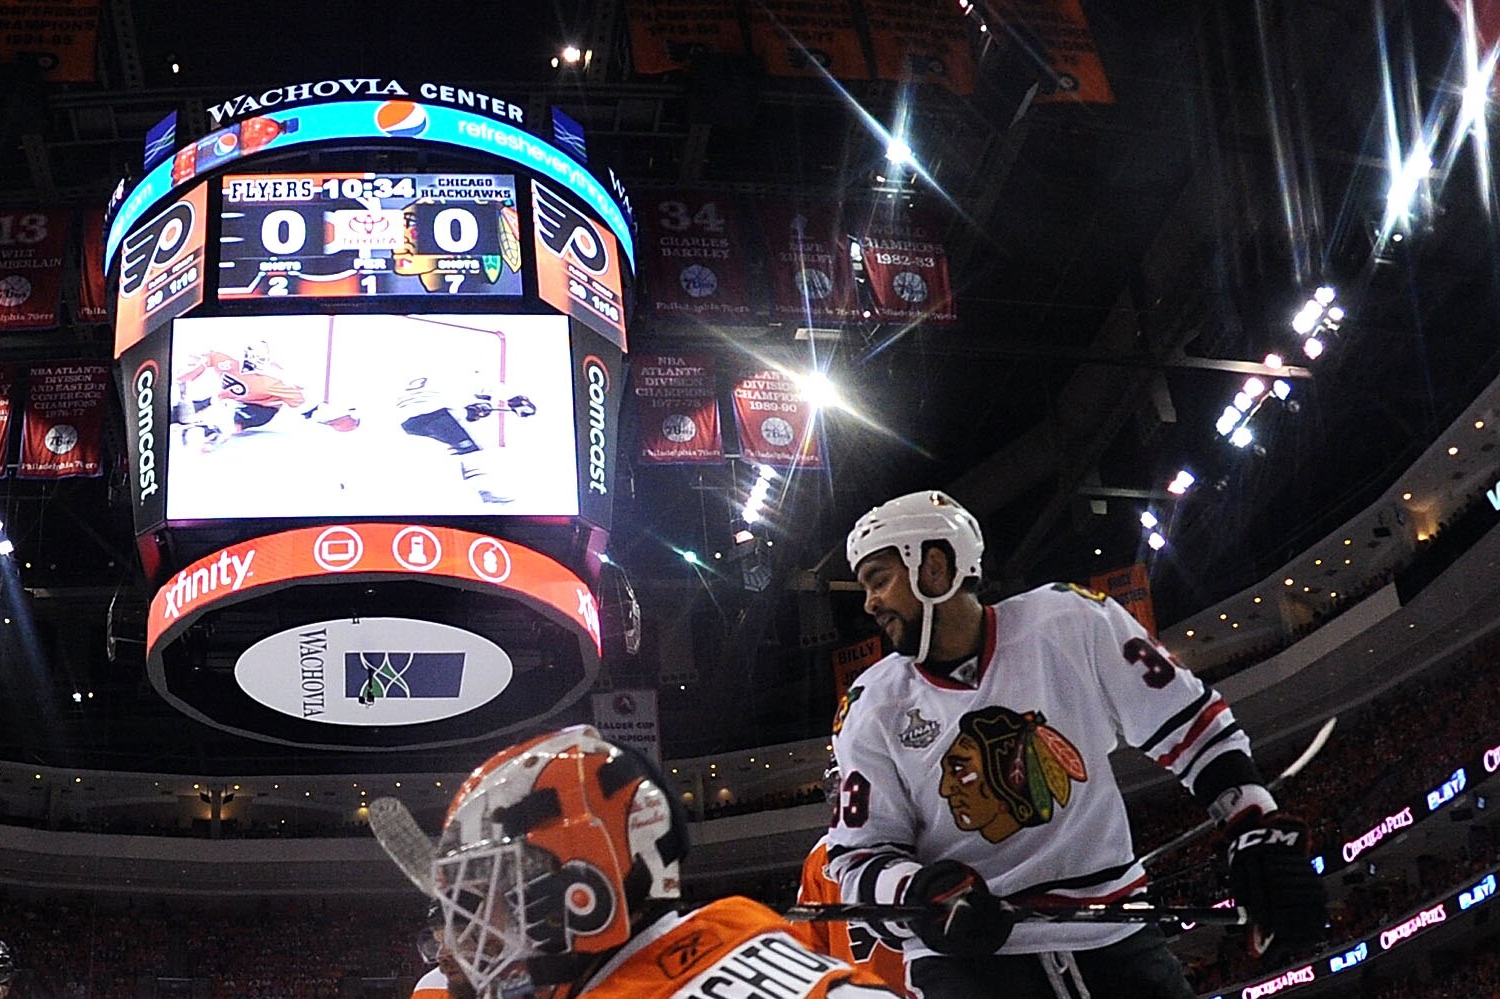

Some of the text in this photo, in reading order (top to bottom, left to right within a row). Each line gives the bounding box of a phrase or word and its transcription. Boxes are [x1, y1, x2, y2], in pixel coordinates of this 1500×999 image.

[206, 77, 524, 123] WACHOVIA CENTER
[232, 180, 312, 199] FLYERS
[323, 178, 415, 199] 10:34
[437, 178, 493, 187] CHICAGO
[421, 188, 511, 198] BLACKHAWKS
[658, 200, 725, 232] 34
[261, 209, 306, 255] 0
[433, 208, 479, 253] 0
[659, 236, 730, 248] CHARLES
[354, 258, 386, 270] PER
[876, 253, 937, 268] 1982-83
[268, 277, 289, 296] 2
[360, 275, 377, 295] 1
[444, 274, 465, 294] 7
[658, 356, 685, 366] NBA
[641, 367, 706, 376] ATLANTIC
[645, 377, 702, 387] DIVISION
[636, 387, 714, 397] CHAMPIONS
[749, 400, 797, 412] 1989-90
[138, 370, 159, 500] comcast
[588, 365, 608, 496] comcast
[164, 549, 256, 619] xfinity
[836, 642, 875, 665] BILLY
[299, 628, 327, 717] WACHOVIA
